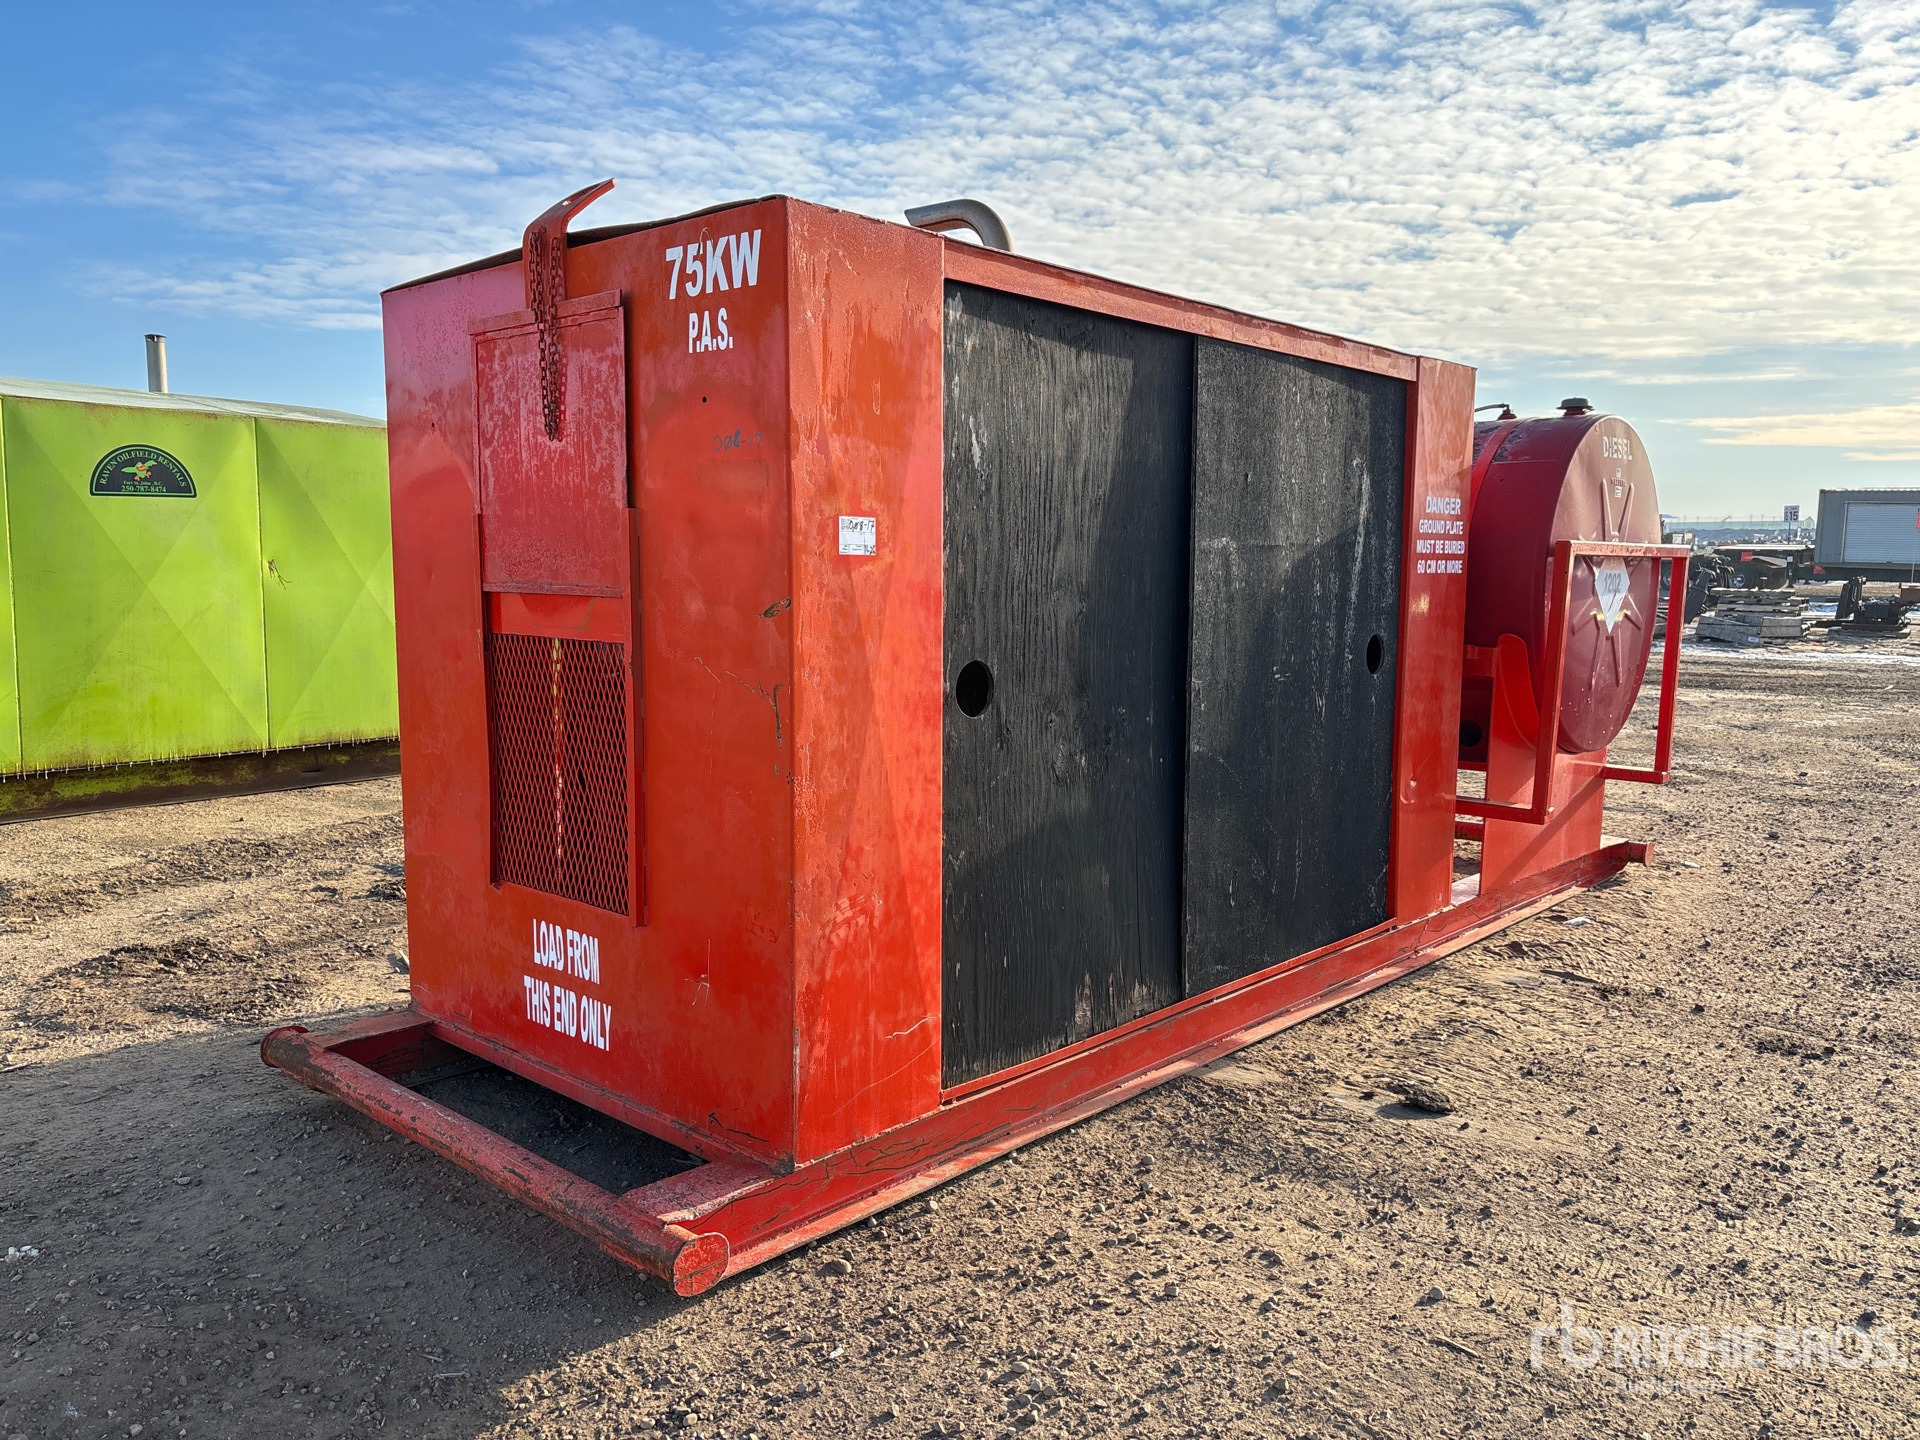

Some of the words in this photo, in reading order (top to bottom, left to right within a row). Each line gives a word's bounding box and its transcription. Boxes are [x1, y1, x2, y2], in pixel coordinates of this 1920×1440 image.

[665, 229, 762, 300] 75KW
[688, 307, 734, 353] P.A.S.
[1603, 435, 1633, 460] DIESEL
[100, 460, 118, 485] RAVEN
[117, 451, 157, 462] OILFIELD
[157, 456, 186, 487] RENTALS
[121, 485, 167, 493] 250-787-8474
[1425, 496, 1461, 515] DANGER
[1789, 510, 1799, 521] 15
[1419, 519, 1445, 534] GROUND
[1445, 520, 1464, 535] PLATE
[1416, 539, 1435, 554] MUST
[1435, 540, 1444, 554] BE
[1444, 540, 1465, 555] BURIED
[1417, 560, 1425, 574] 60
[1426, 560, 1436, 574] CM
[1437, 560, 1446, 574] OR
[1446, 561, 1463, 574] MORE
[1603, 572, 1621, 594] 1202
[533, 918, 565, 972] LOAD
[566, 928, 600, 985] FROM
[523, 974, 551, 1028] THIS
[553, 985, 577, 1038] END
[580, 994, 612, 1052] ONLY
